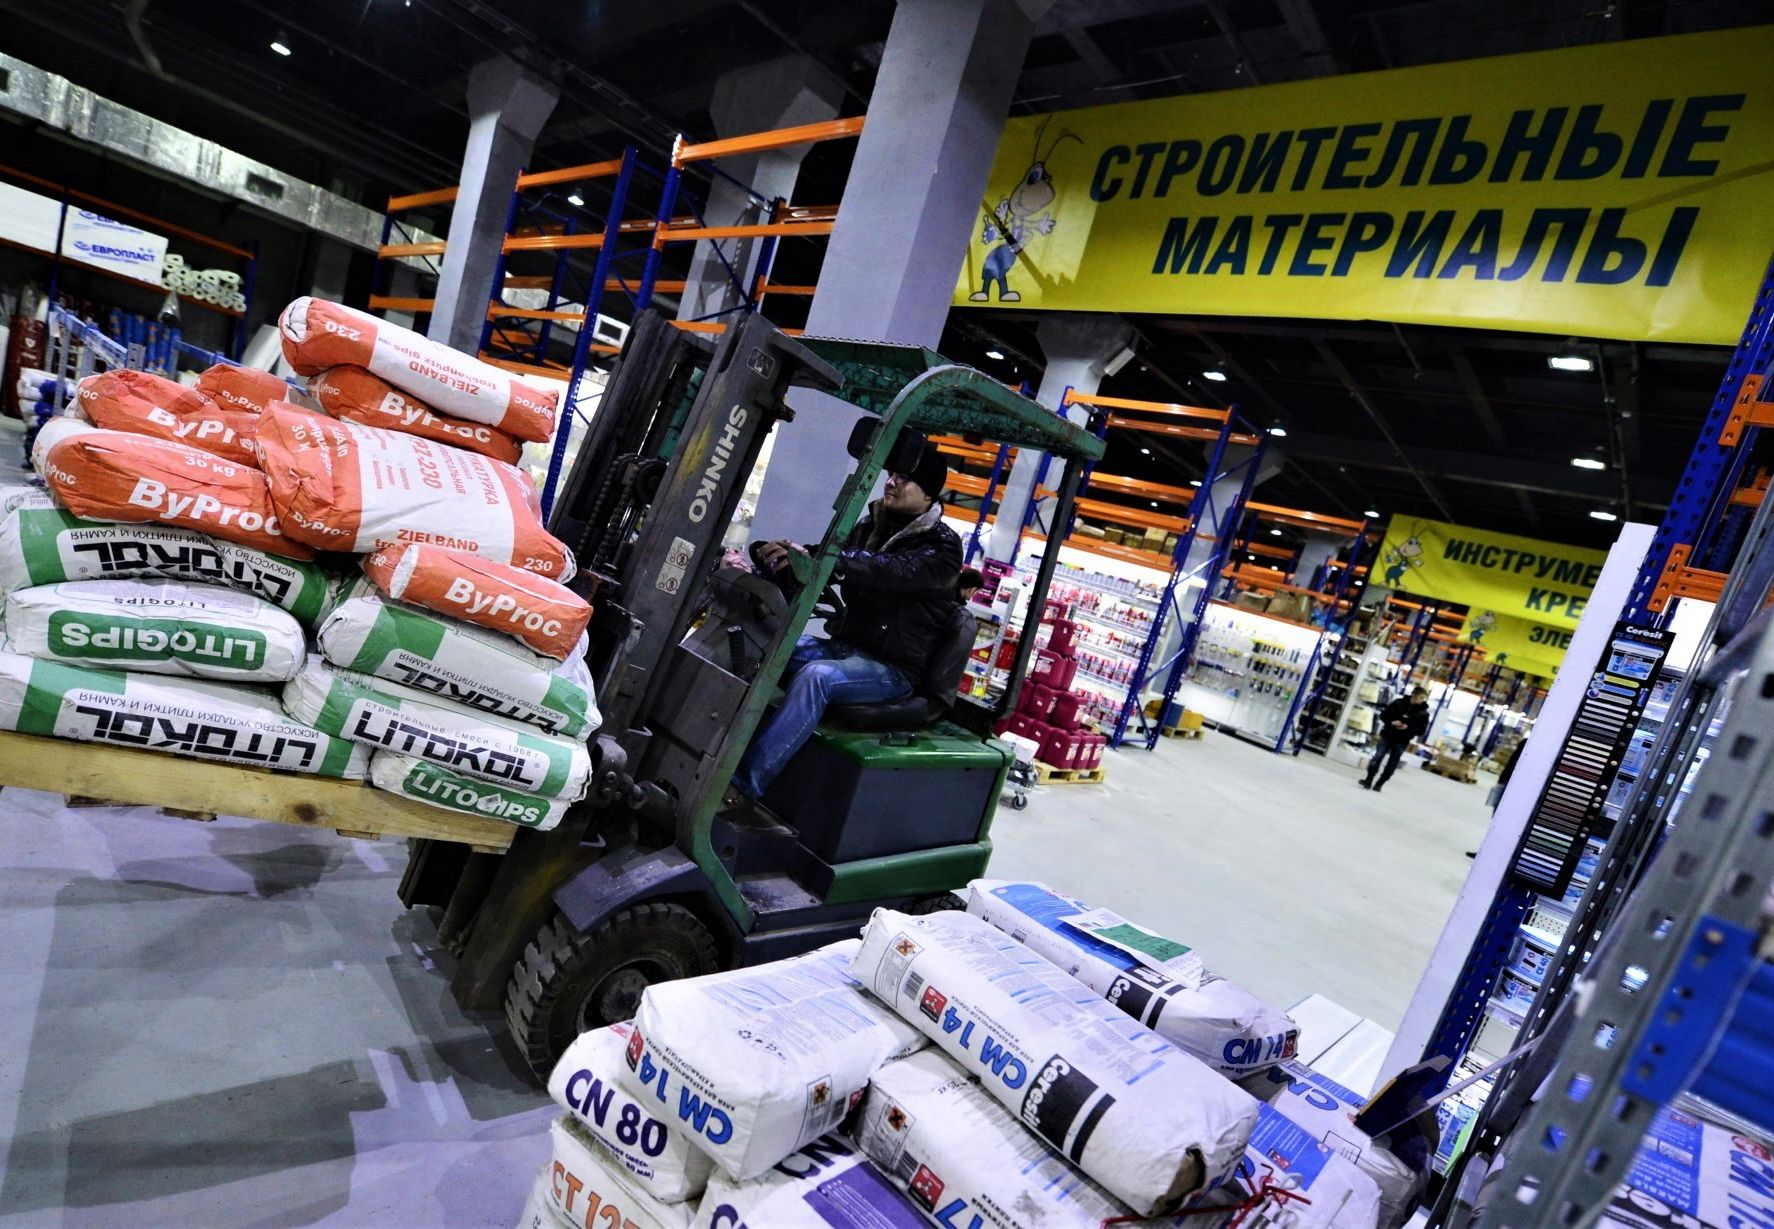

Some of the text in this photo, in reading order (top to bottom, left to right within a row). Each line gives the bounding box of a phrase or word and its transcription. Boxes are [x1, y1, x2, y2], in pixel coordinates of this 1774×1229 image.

[1090, 94, 1746, 201] СТРОИТЕЛЬНЫЕ
[92, 244, 155, 263] ЕВРОПЛАСТ
[1150, 206, 1701, 287] МАТЕРИАЛЫ
[324, 319, 362, 342] 230
[409, 360, 481, 396] ZIELBAND
[185, 455, 208, 469] 30
[689, 404, 747, 523] SHINKO
[128, 477, 282, 536] ByProc
[70, 530, 116, 541] КАМНЯ
[396, 528, 479, 552] ZIELBAND
[523, 556, 554, 572] 230
[444, 576, 563, 638] ByProc
[60, 622, 257, 661] LITOGIPS
[398, 652, 433, 670] КАМНЯ
[79, 692, 127, 707] КАМНЯ
[130, 699, 139, 710] И
[143, 701, 195, 719] ПЛИТКИ
[76, 704, 317, 767] LITOKOL
[353, 710, 533, 786] LITOKOL
[942, 1007, 1027, 1089] CM 14
[1223, 1037, 1262, 1065] CM
[640, 1051, 668, 1103] 14
[566, 1068, 615, 1128] CN
[616, 1103, 668, 1157] 80
[679, 1086, 734, 1145] CM
